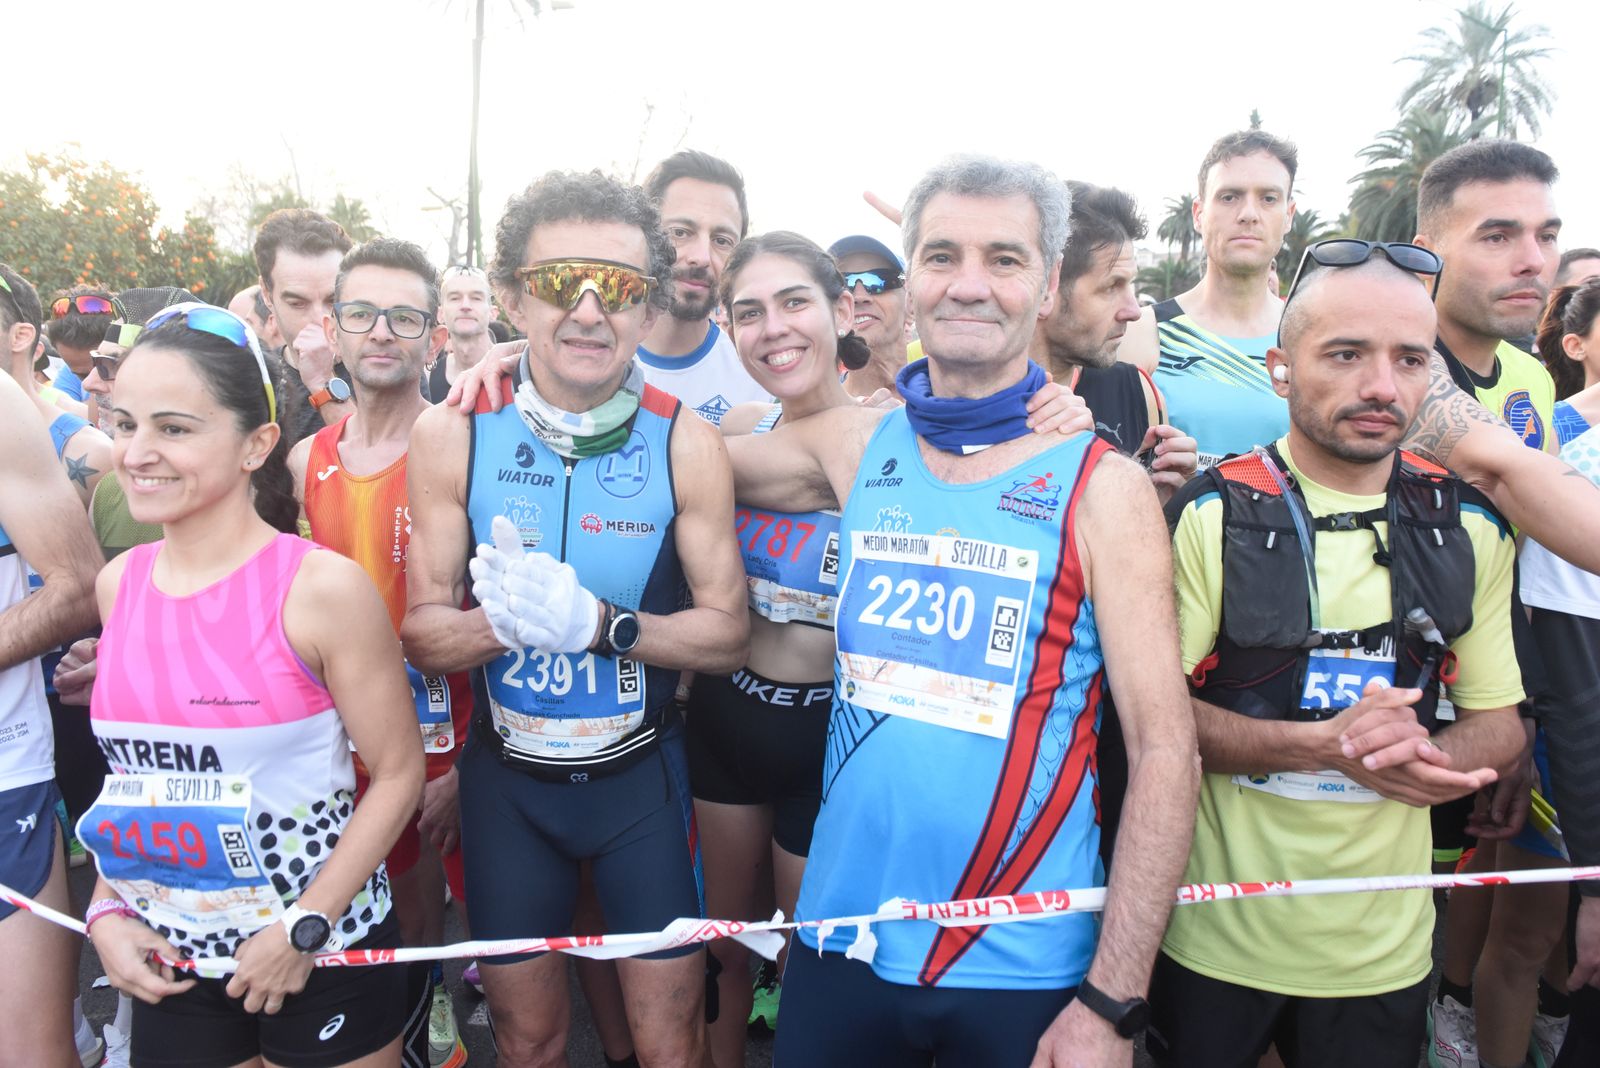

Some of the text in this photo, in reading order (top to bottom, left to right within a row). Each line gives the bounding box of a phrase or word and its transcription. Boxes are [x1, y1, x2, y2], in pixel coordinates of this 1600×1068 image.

[1197, 454, 1219, 466] MARA
[498, 468, 555, 488] VIATOR
[865, 477, 903, 488] VIATOR
[392, 506, 402, 563] ATLETISMO
[735, 508, 816, 563] 2787
[863, 535, 1007, 571] MEDIO MARATÓN SEVILLA
[858, 575, 975, 640] 2230
[891, 631, 932, 646] Contador
[502, 648, 597, 695] 2391
[99, 736, 222, 773] NTRENA
[545, 740, 570, 749] HOKA
[166, 777, 222, 802] SEVILLA
[1317, 783, 1345, 793] HOKA
[97, 819, 208, 869] 2159
